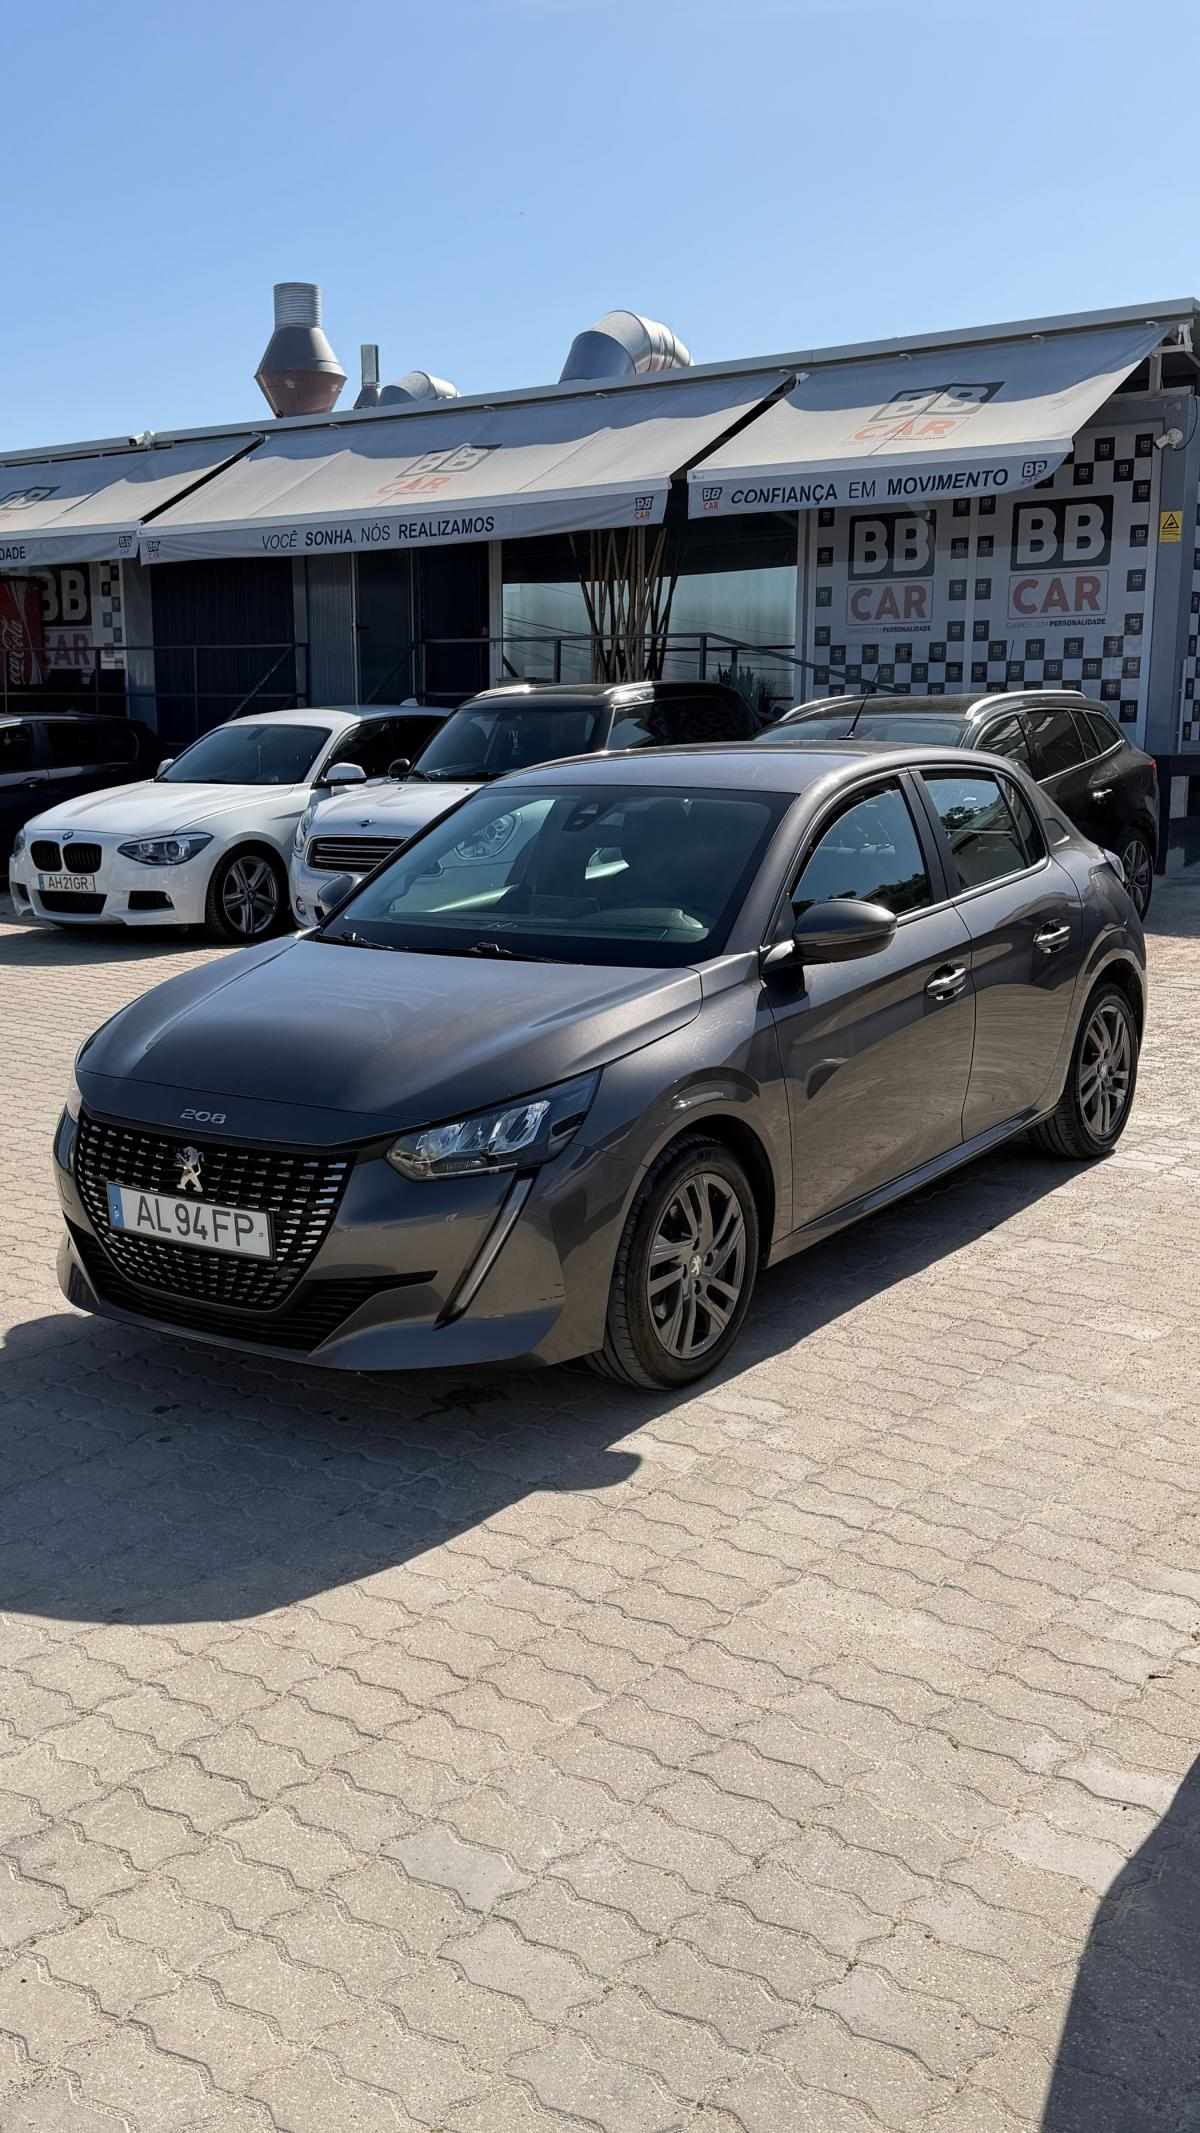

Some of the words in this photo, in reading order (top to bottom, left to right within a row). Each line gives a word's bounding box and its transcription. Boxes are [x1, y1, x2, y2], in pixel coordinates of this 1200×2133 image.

[871, 384, 996, 420] BB
[731, 483, 838, 506] CONFIANÇA
[848, 479, 877, 499] EM
[887, 468, 1009, 496] MOVIMENTO
[262, 530, 298, 550] VOCÊ
[361, 522, 391, 543] NÓS
[398, 515, 495, 540] REALIZAMOS
[853, 517, 930, 575] BB
[1016, 503, 1105, 565] BB
[850, 585, 929, 621] CAR
[1013, 575, 1101, 614] CAR
[48, 633, 91, 666] AR
[179, 1108, 227, 1125] 208
